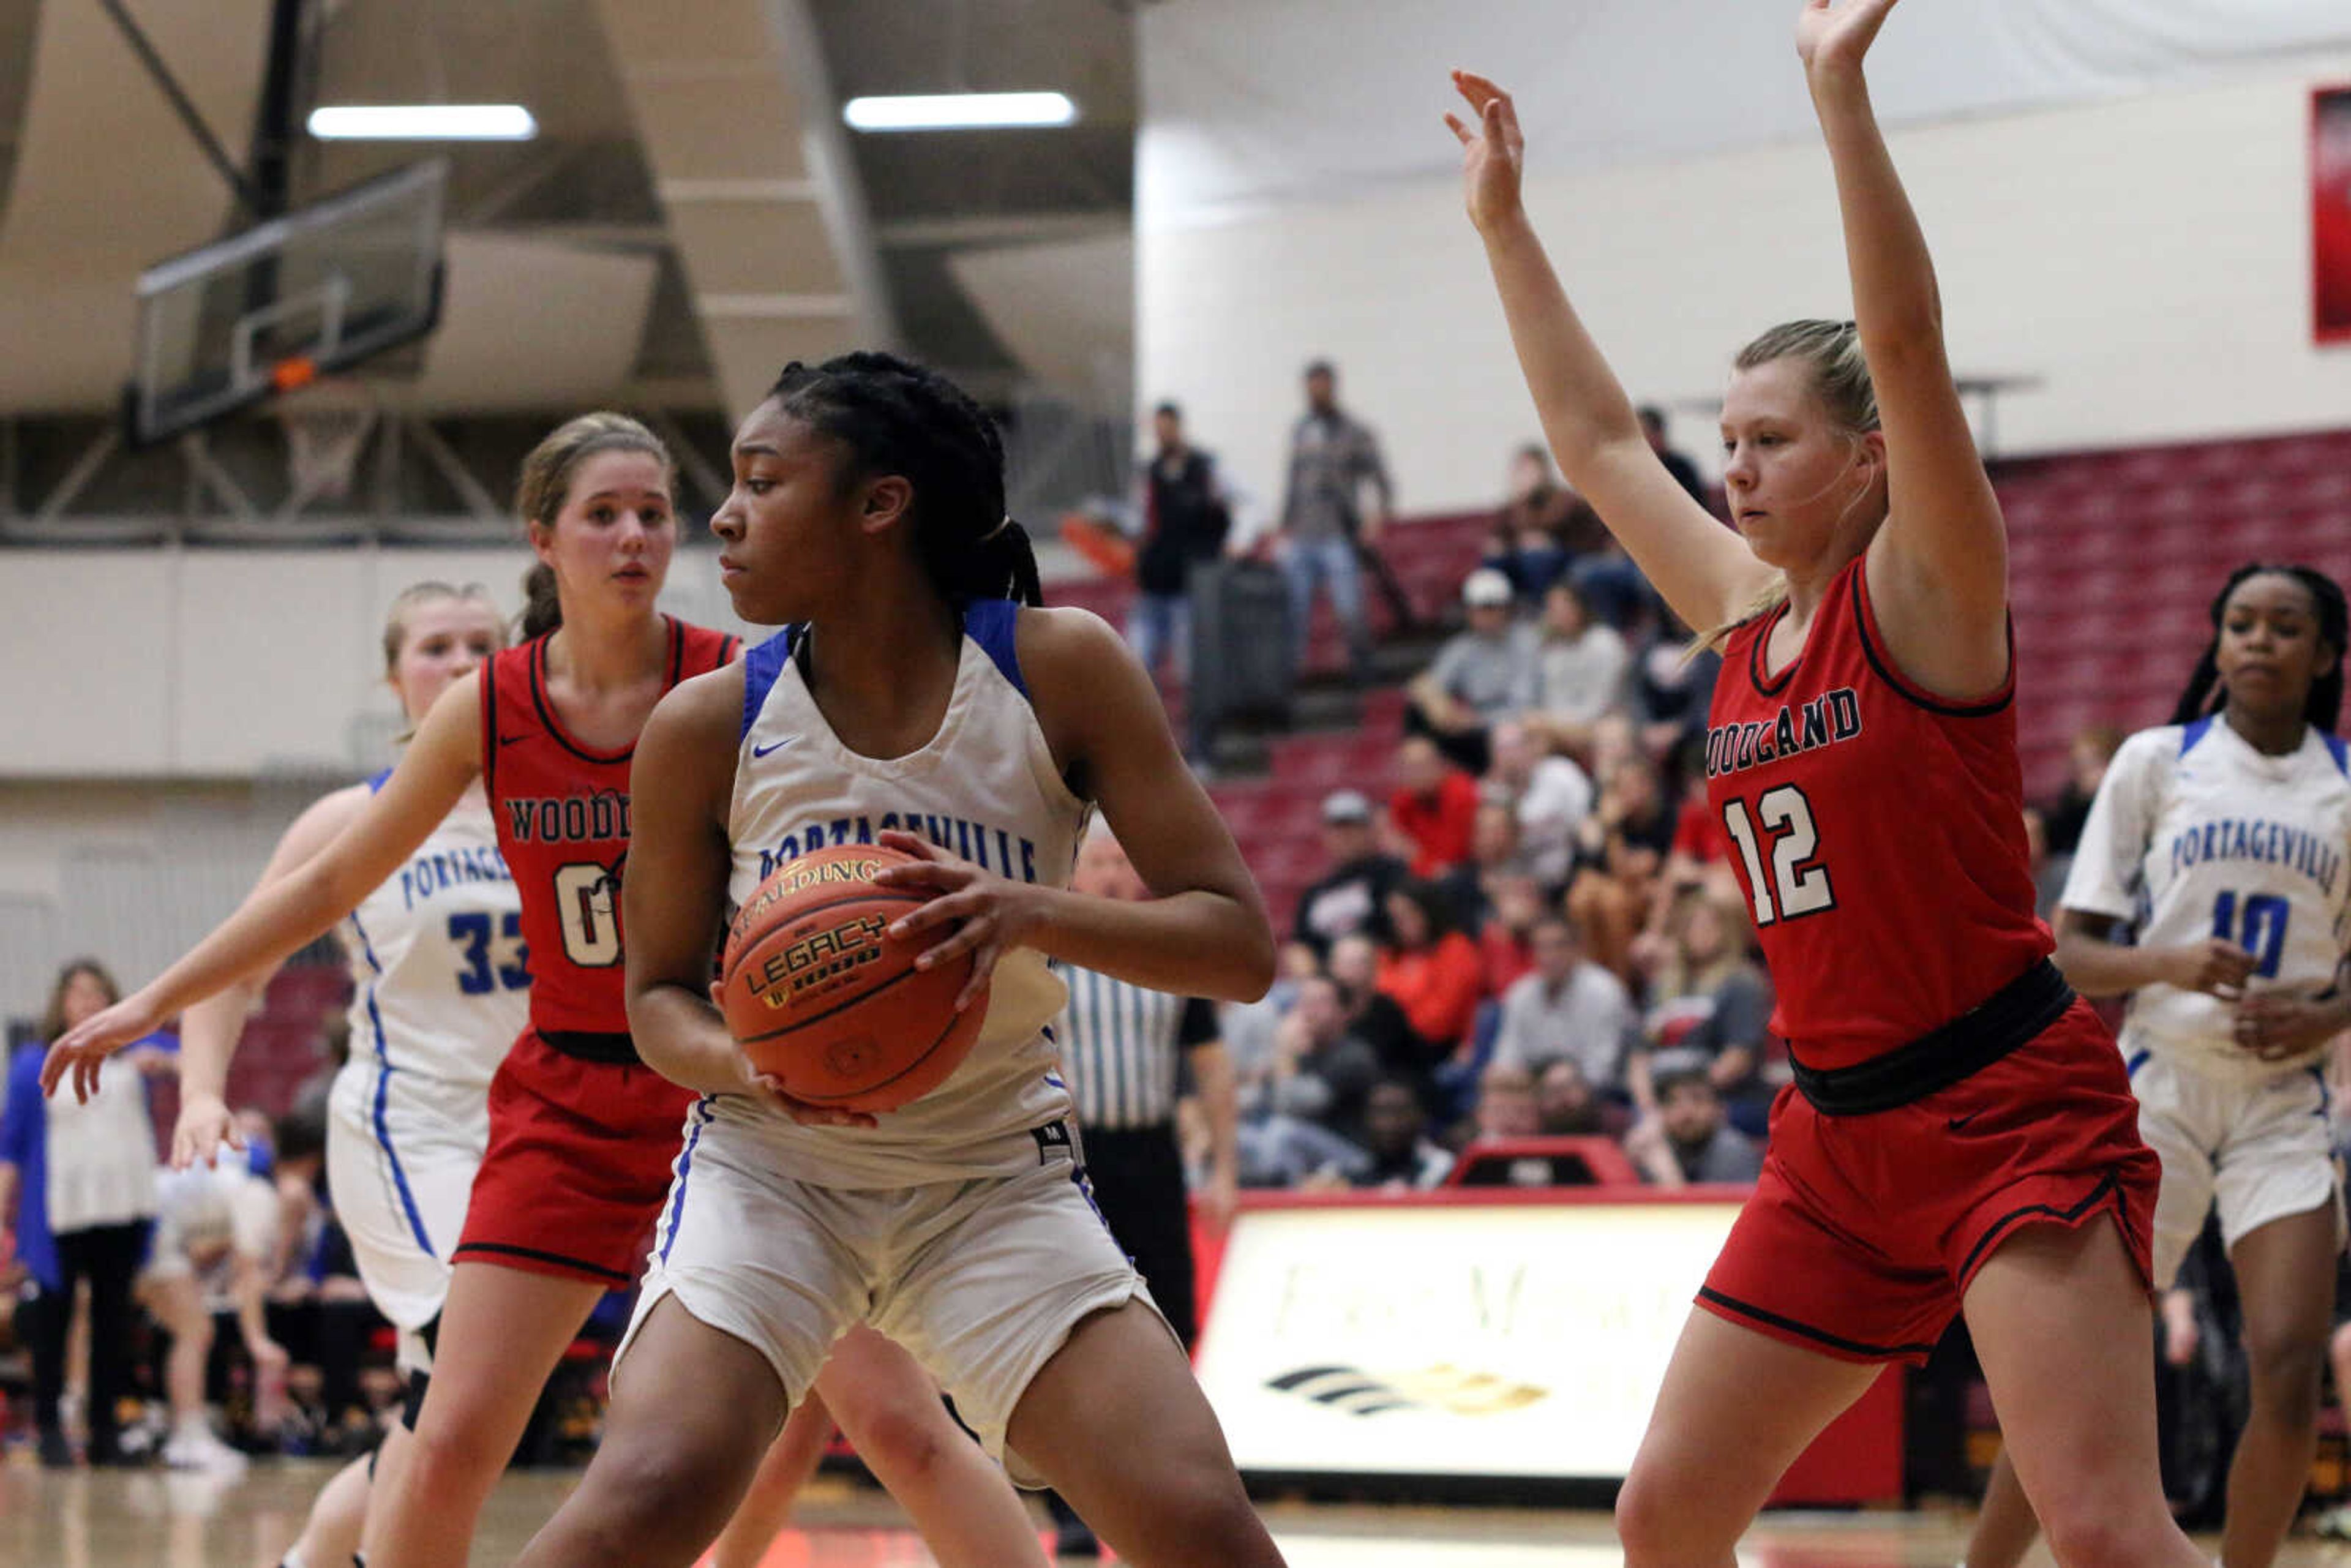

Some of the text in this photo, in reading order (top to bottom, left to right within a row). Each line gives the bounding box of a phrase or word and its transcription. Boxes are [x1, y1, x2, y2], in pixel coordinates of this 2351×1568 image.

[1706, 687, 1863, 779] OODLAND
[1722, 782, 1838, 929] 12
[448, 912, 534, 996] 33
[747, 912, 887, 997] LEGACY
[2211, 890, 2290, 978] 10
